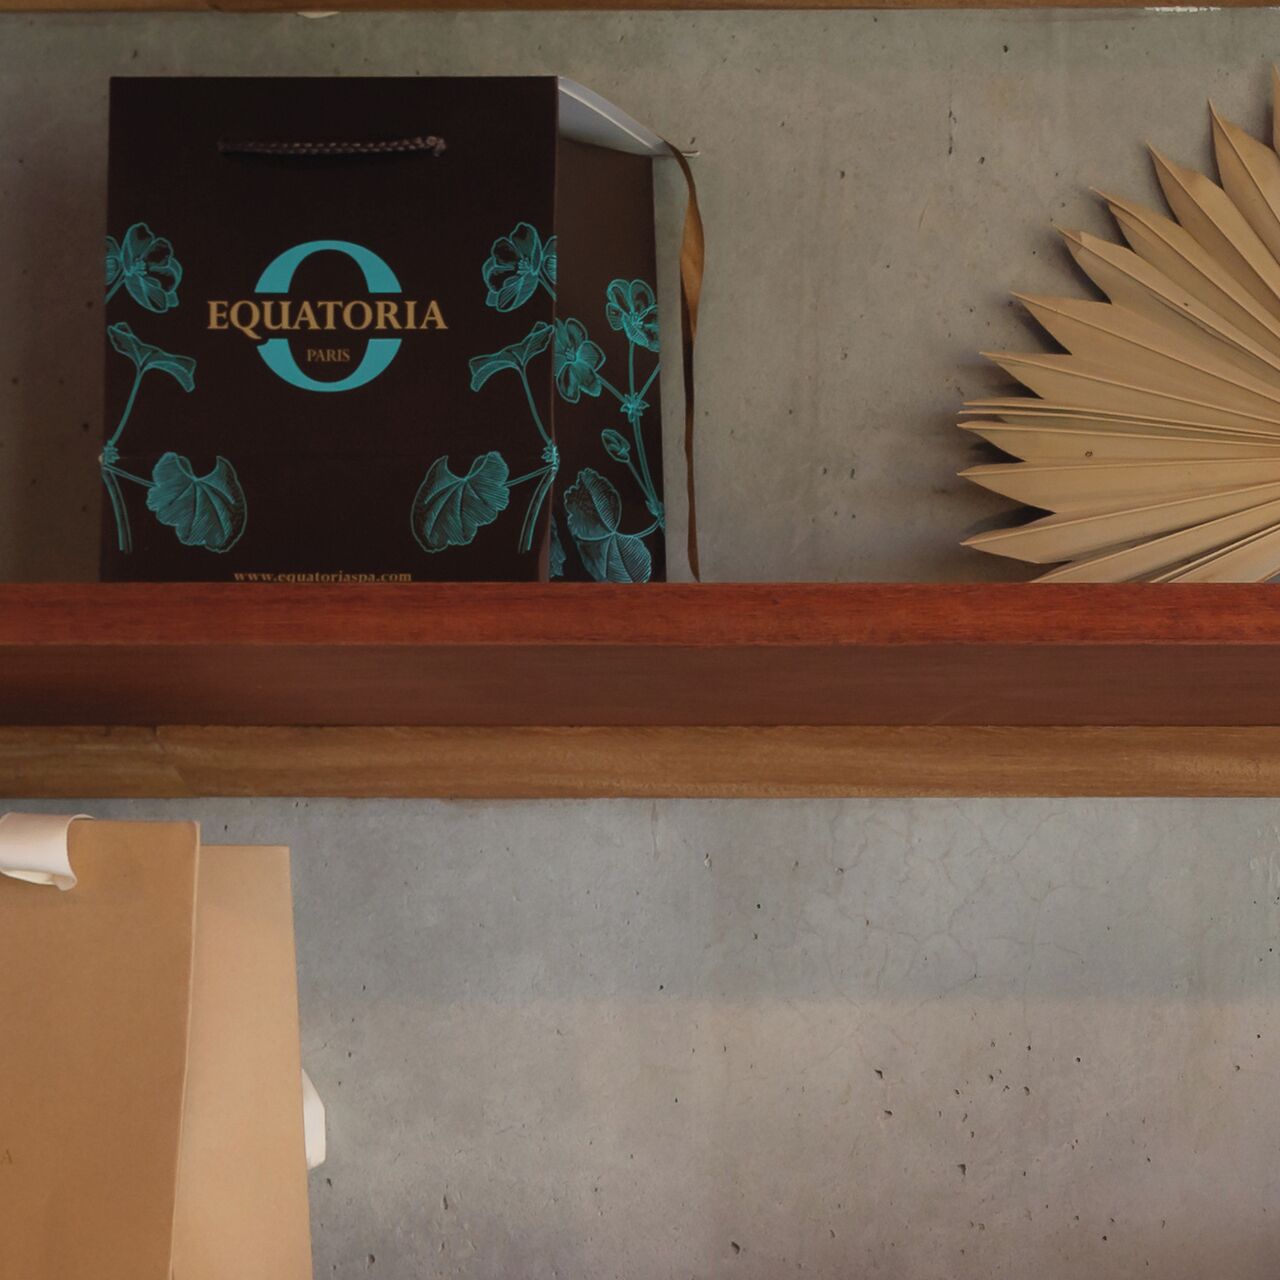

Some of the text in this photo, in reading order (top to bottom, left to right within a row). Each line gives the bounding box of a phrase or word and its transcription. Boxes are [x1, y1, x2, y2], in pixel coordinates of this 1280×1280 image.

[206, 300, 448, 339] EQUATORIA
[306, 348, 350, 362] PARIS
[234, 570, 412, 583] www.equatoriaspa.com
